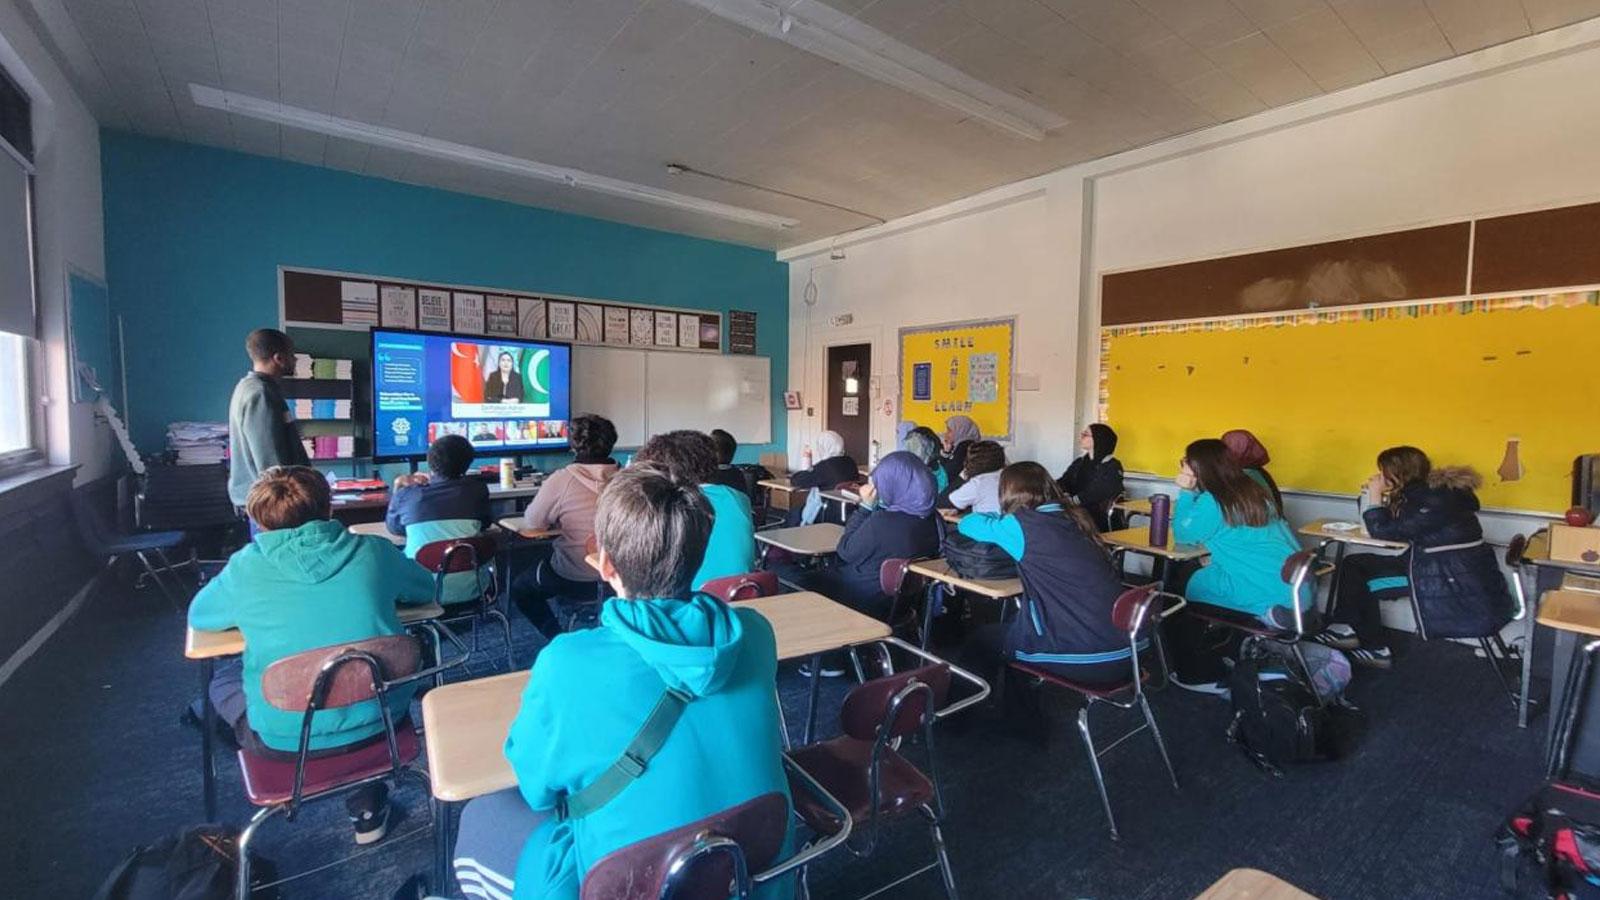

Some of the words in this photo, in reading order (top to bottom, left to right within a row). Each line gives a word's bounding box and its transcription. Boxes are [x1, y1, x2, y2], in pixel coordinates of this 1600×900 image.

[934, 337, 974, 349] SMILE
[949, 358, 959, 391] AND
[934, 401, 973, 412] LEARN
